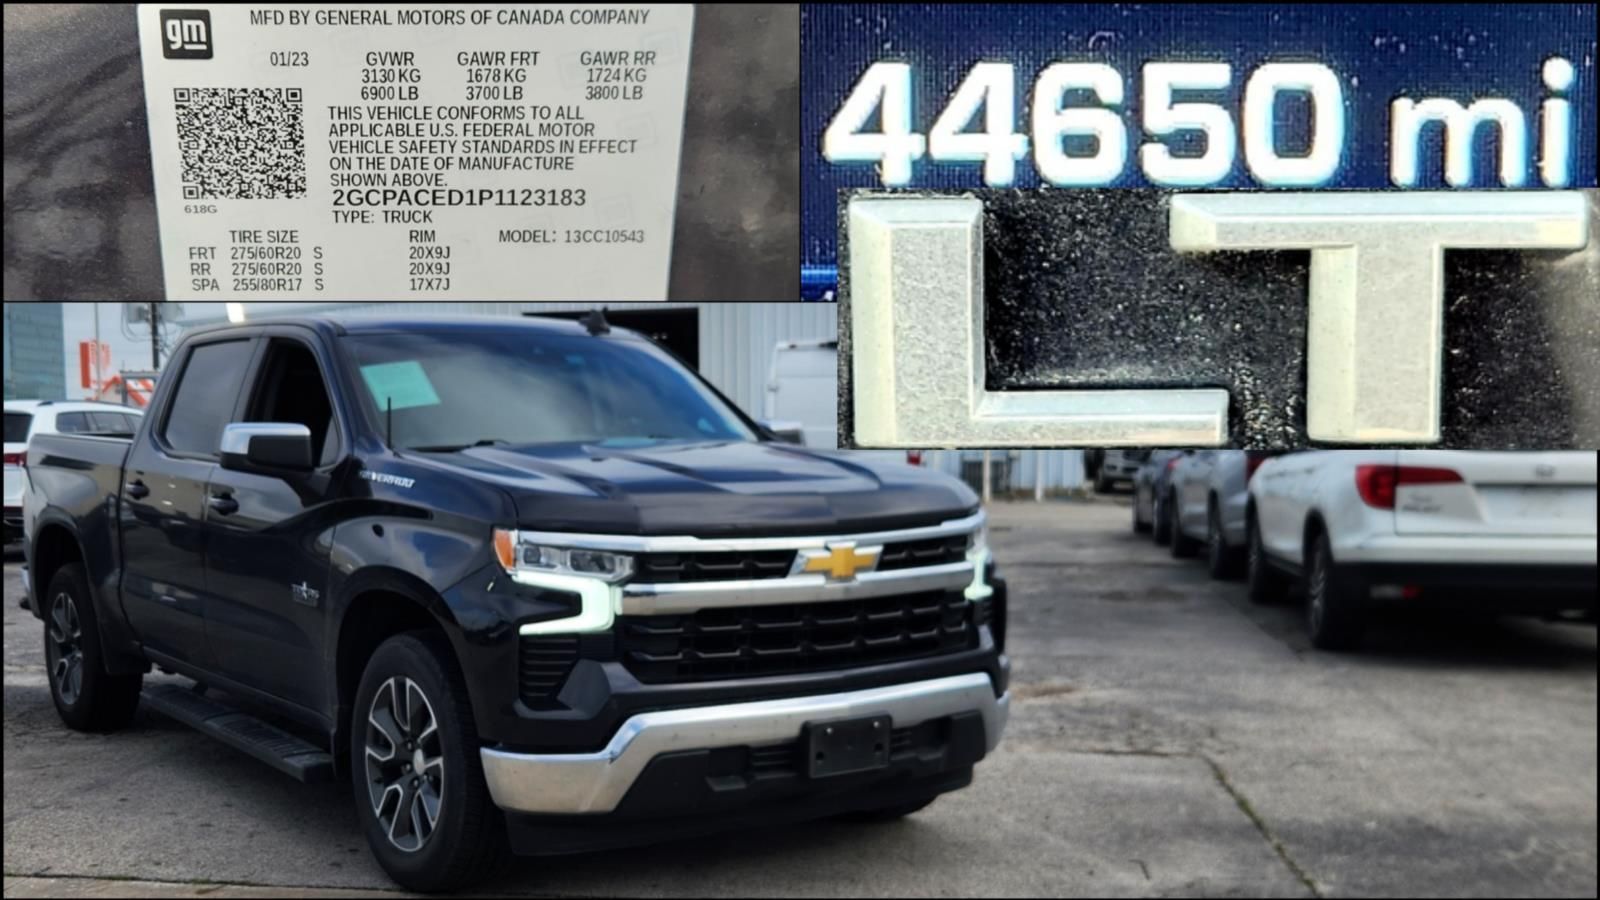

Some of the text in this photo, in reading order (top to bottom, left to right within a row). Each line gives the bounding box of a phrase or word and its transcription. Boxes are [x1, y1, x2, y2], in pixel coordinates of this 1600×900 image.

[250, 10, 650, 25] MFD BY GENERAL MOTORS OF CANADA COMPANY
[166, 19, 208, 50] gm
[269, 51, 310, 67] 01/23
[365, 52, 415, 66] GVWR
[456, 51, 541, 66] GAWR FRT
[580, 51, 657, 65] GAWR RR
[361, 68, 422, 83] 3130 KG
[466, 68, 527, 83] 1678 KG
[587, 68, 647, 82] 1724 KG
[360, 86, 420, 100] 6900 LB
[465, 86, 524, 100] 3700 LB
[585, 86, 644, 100] 3800 LB
[327, 106, 585, 120] THIS VEHICLE CONFORMS TO ALL
[822, 56, 1574, 187] 44650 mi
[328, 123, 596, 137] APPLICABLE U.S. FEDERAL MOTOR
[328, 140, 638, 154] VEHICLE SAFETY STANDARDS IN EFFECT
[329, 156, 575, 170] ON THE DATE OF MANUFACTURE
[330, 173, 448, 186] SHOWN ABOVE.
[332, 189, 586, 206] 2GCPACED1P1123183
[184, 205, 218, 213] 618G
[332, 210, 433, 224] TYPE: TRUCK
[228, 230, 299, 243] TIRE SIZE
[409, 230, 436, 243] RIM
[498, 230, 644, 243] MODEL: 13CC10543
[188, 247, 323, 259] FRT 275/60R20 S
[409, 246, 451, 259] 20X9J
[190, 263, 324, 275] RR 275/60R20 S
[409, 262, 451, 275] 20X9J
[191, 278, 325, 291] SPA 255/80R17 S
[410, 278, 450, 290] 17X7J
[848, 191, 1588, 447] LT
